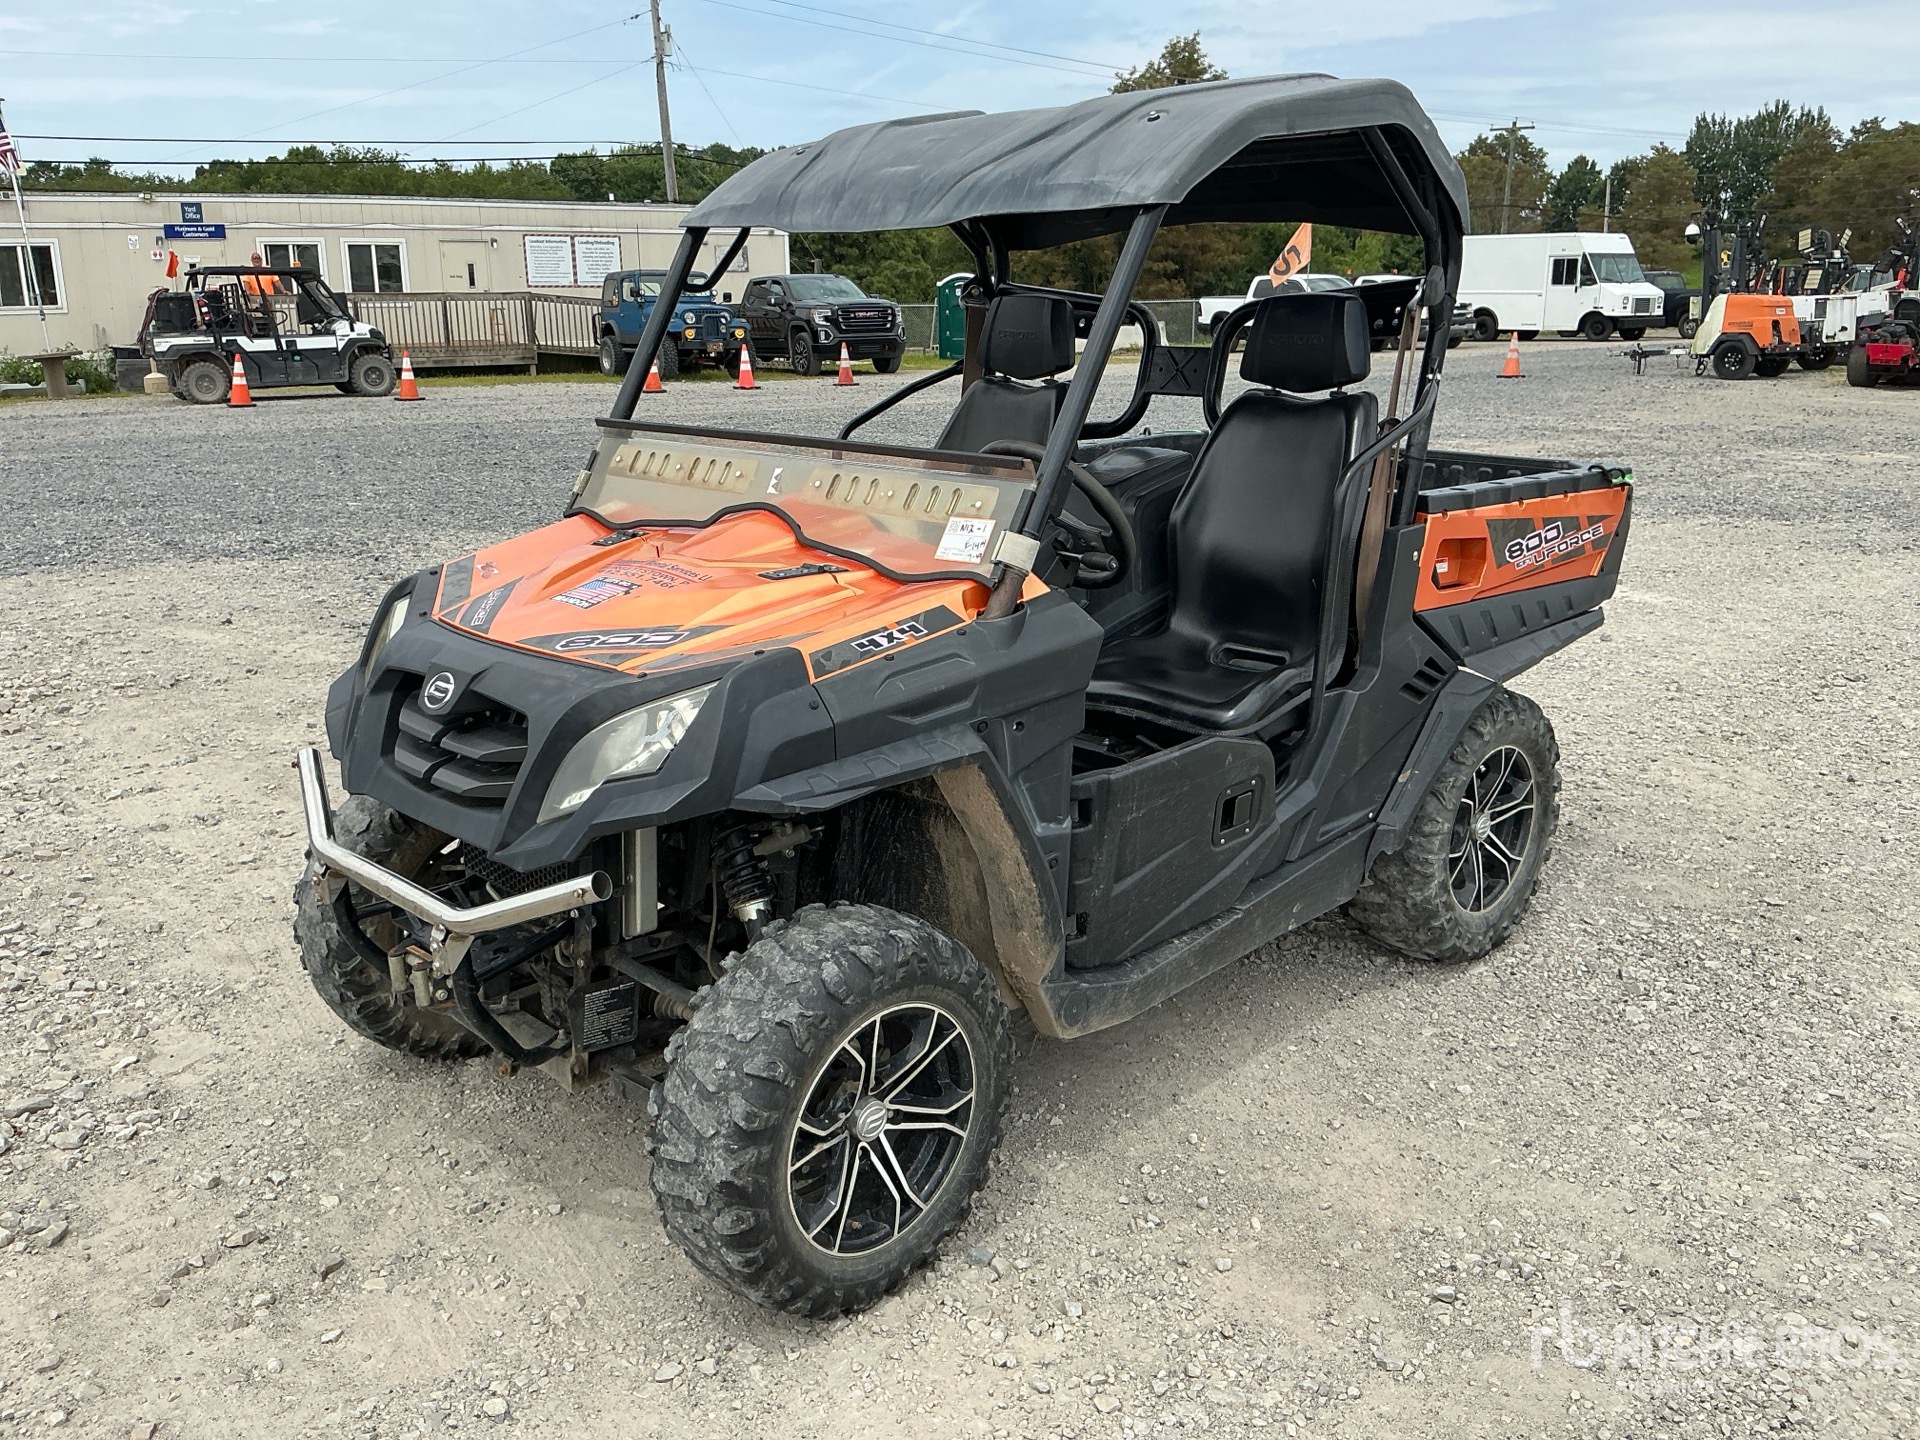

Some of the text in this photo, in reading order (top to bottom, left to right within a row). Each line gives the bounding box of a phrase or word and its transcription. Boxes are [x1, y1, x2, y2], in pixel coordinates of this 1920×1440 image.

[1505, 520, 1563, 563] 800
[1532, 523, 1604, 566] UFORCE
[555, 631, 690, 651] 800
